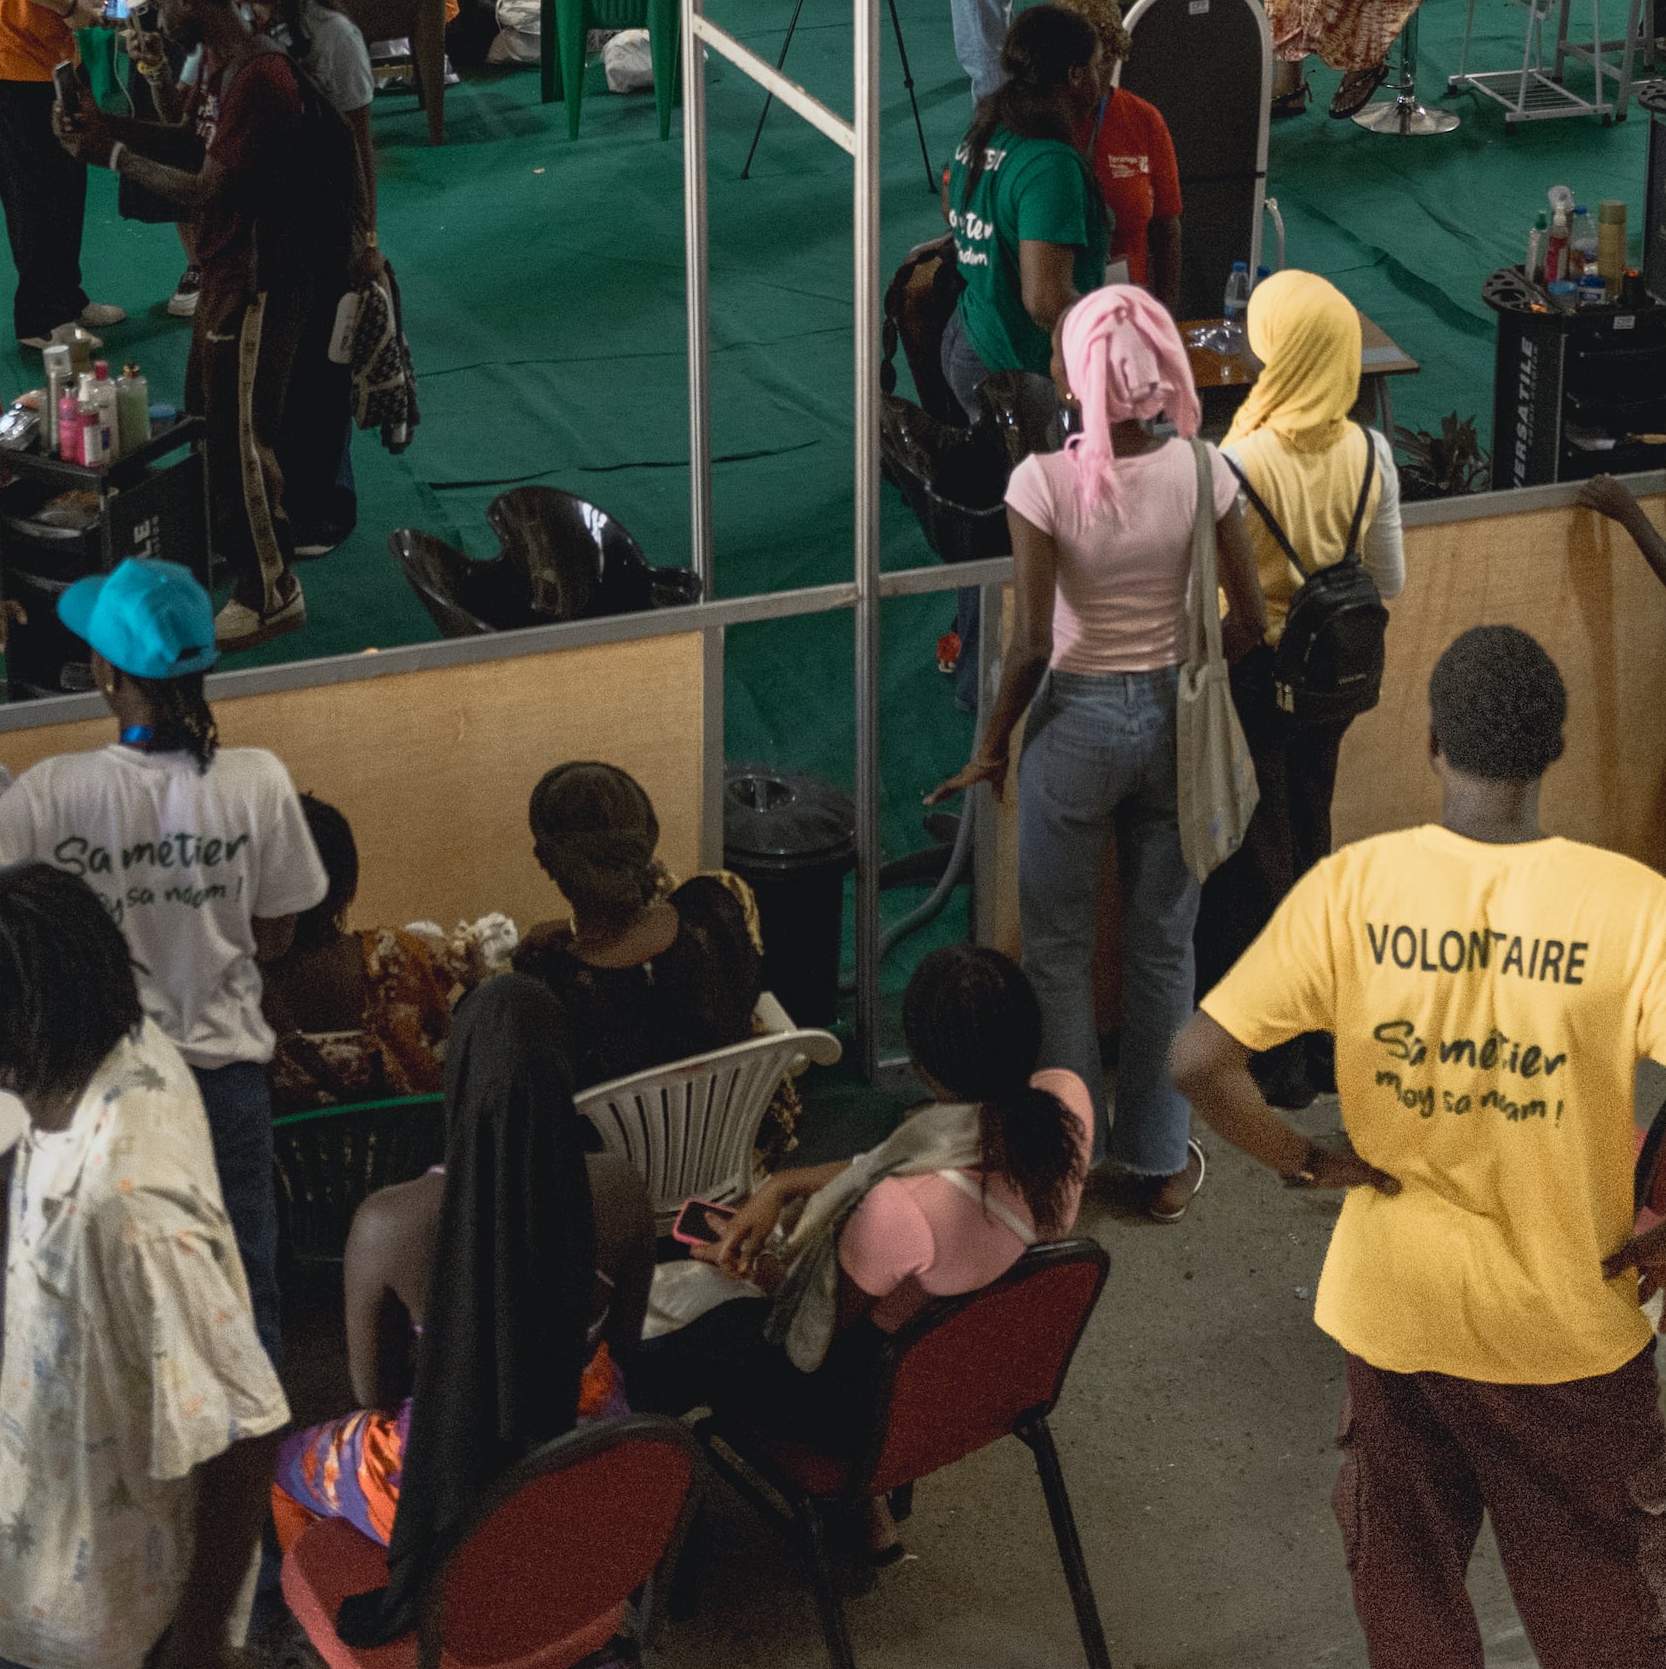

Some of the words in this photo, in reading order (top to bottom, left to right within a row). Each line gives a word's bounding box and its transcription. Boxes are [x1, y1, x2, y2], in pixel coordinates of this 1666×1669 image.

[54, 836, 112, 875] Sa
[121, 832, 250, 870] métier
[126, 886, 155, 907] sa
[1366, 922, 1588, 985] VOLONTAIRE
[1373, 1020, 1428, 1067] Sa
[1439, 1029, 1567, 1079] métier
[1442, 1090, 1472, 1115] sa
